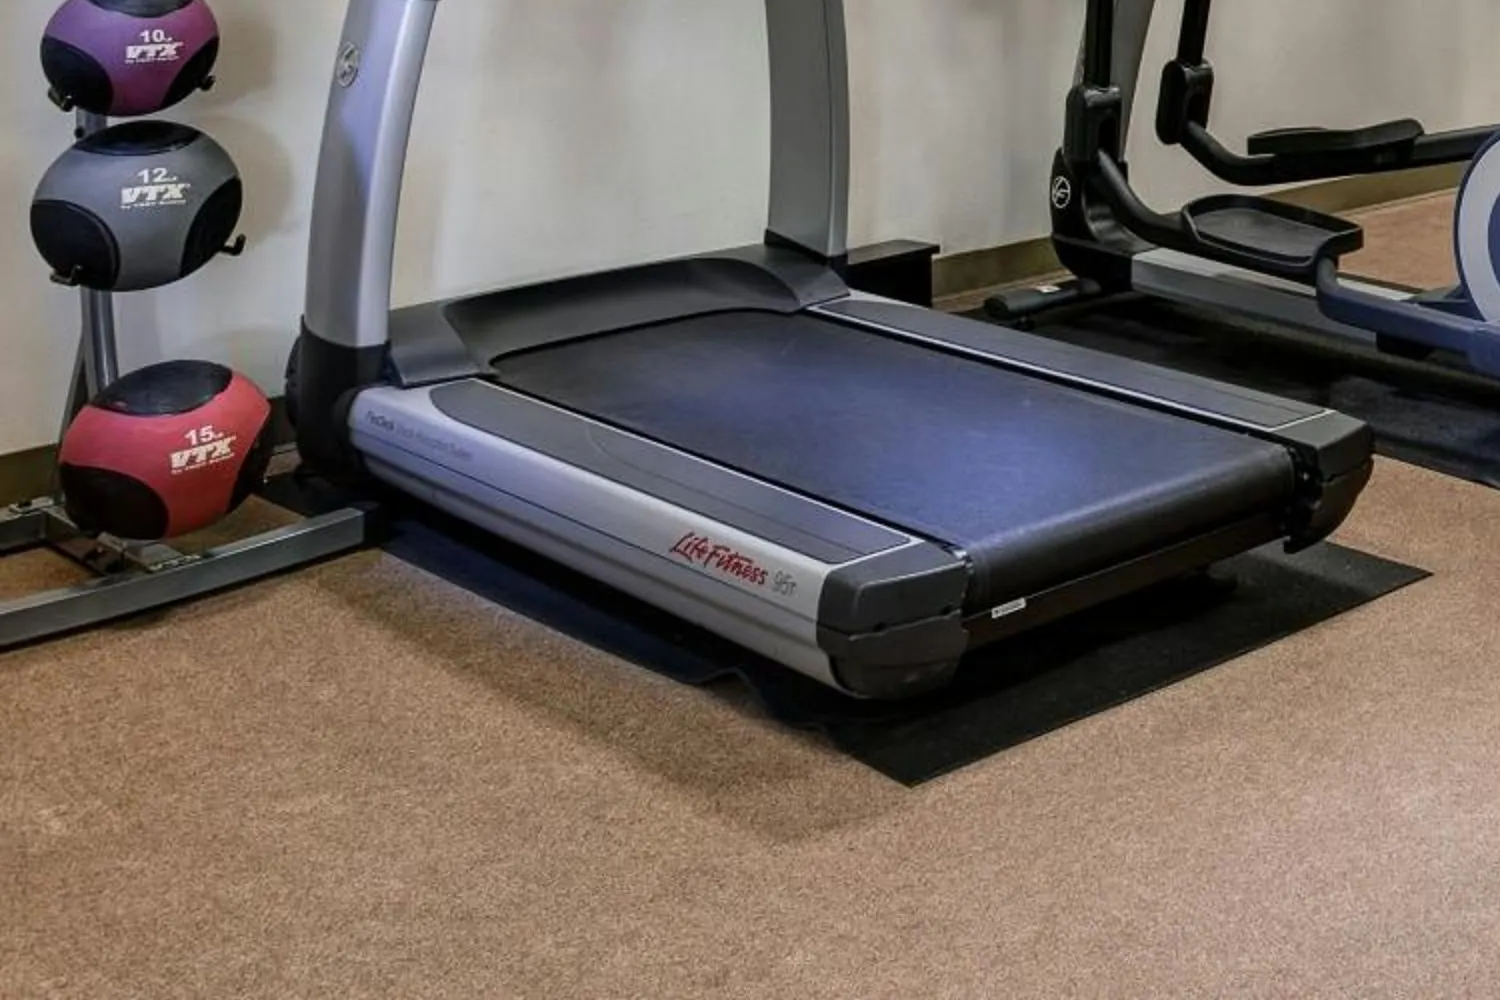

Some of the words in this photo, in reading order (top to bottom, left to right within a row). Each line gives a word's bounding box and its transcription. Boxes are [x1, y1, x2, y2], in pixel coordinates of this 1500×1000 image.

[140, 29, 165, 43] 10
[126, 41, 184, 59] VTX
[138, 167, 168, 184] 12
[121, 183, 191, 205] VTX
[184, 424, 215, 446] 15
[170, 435, 237, 469] VTX
